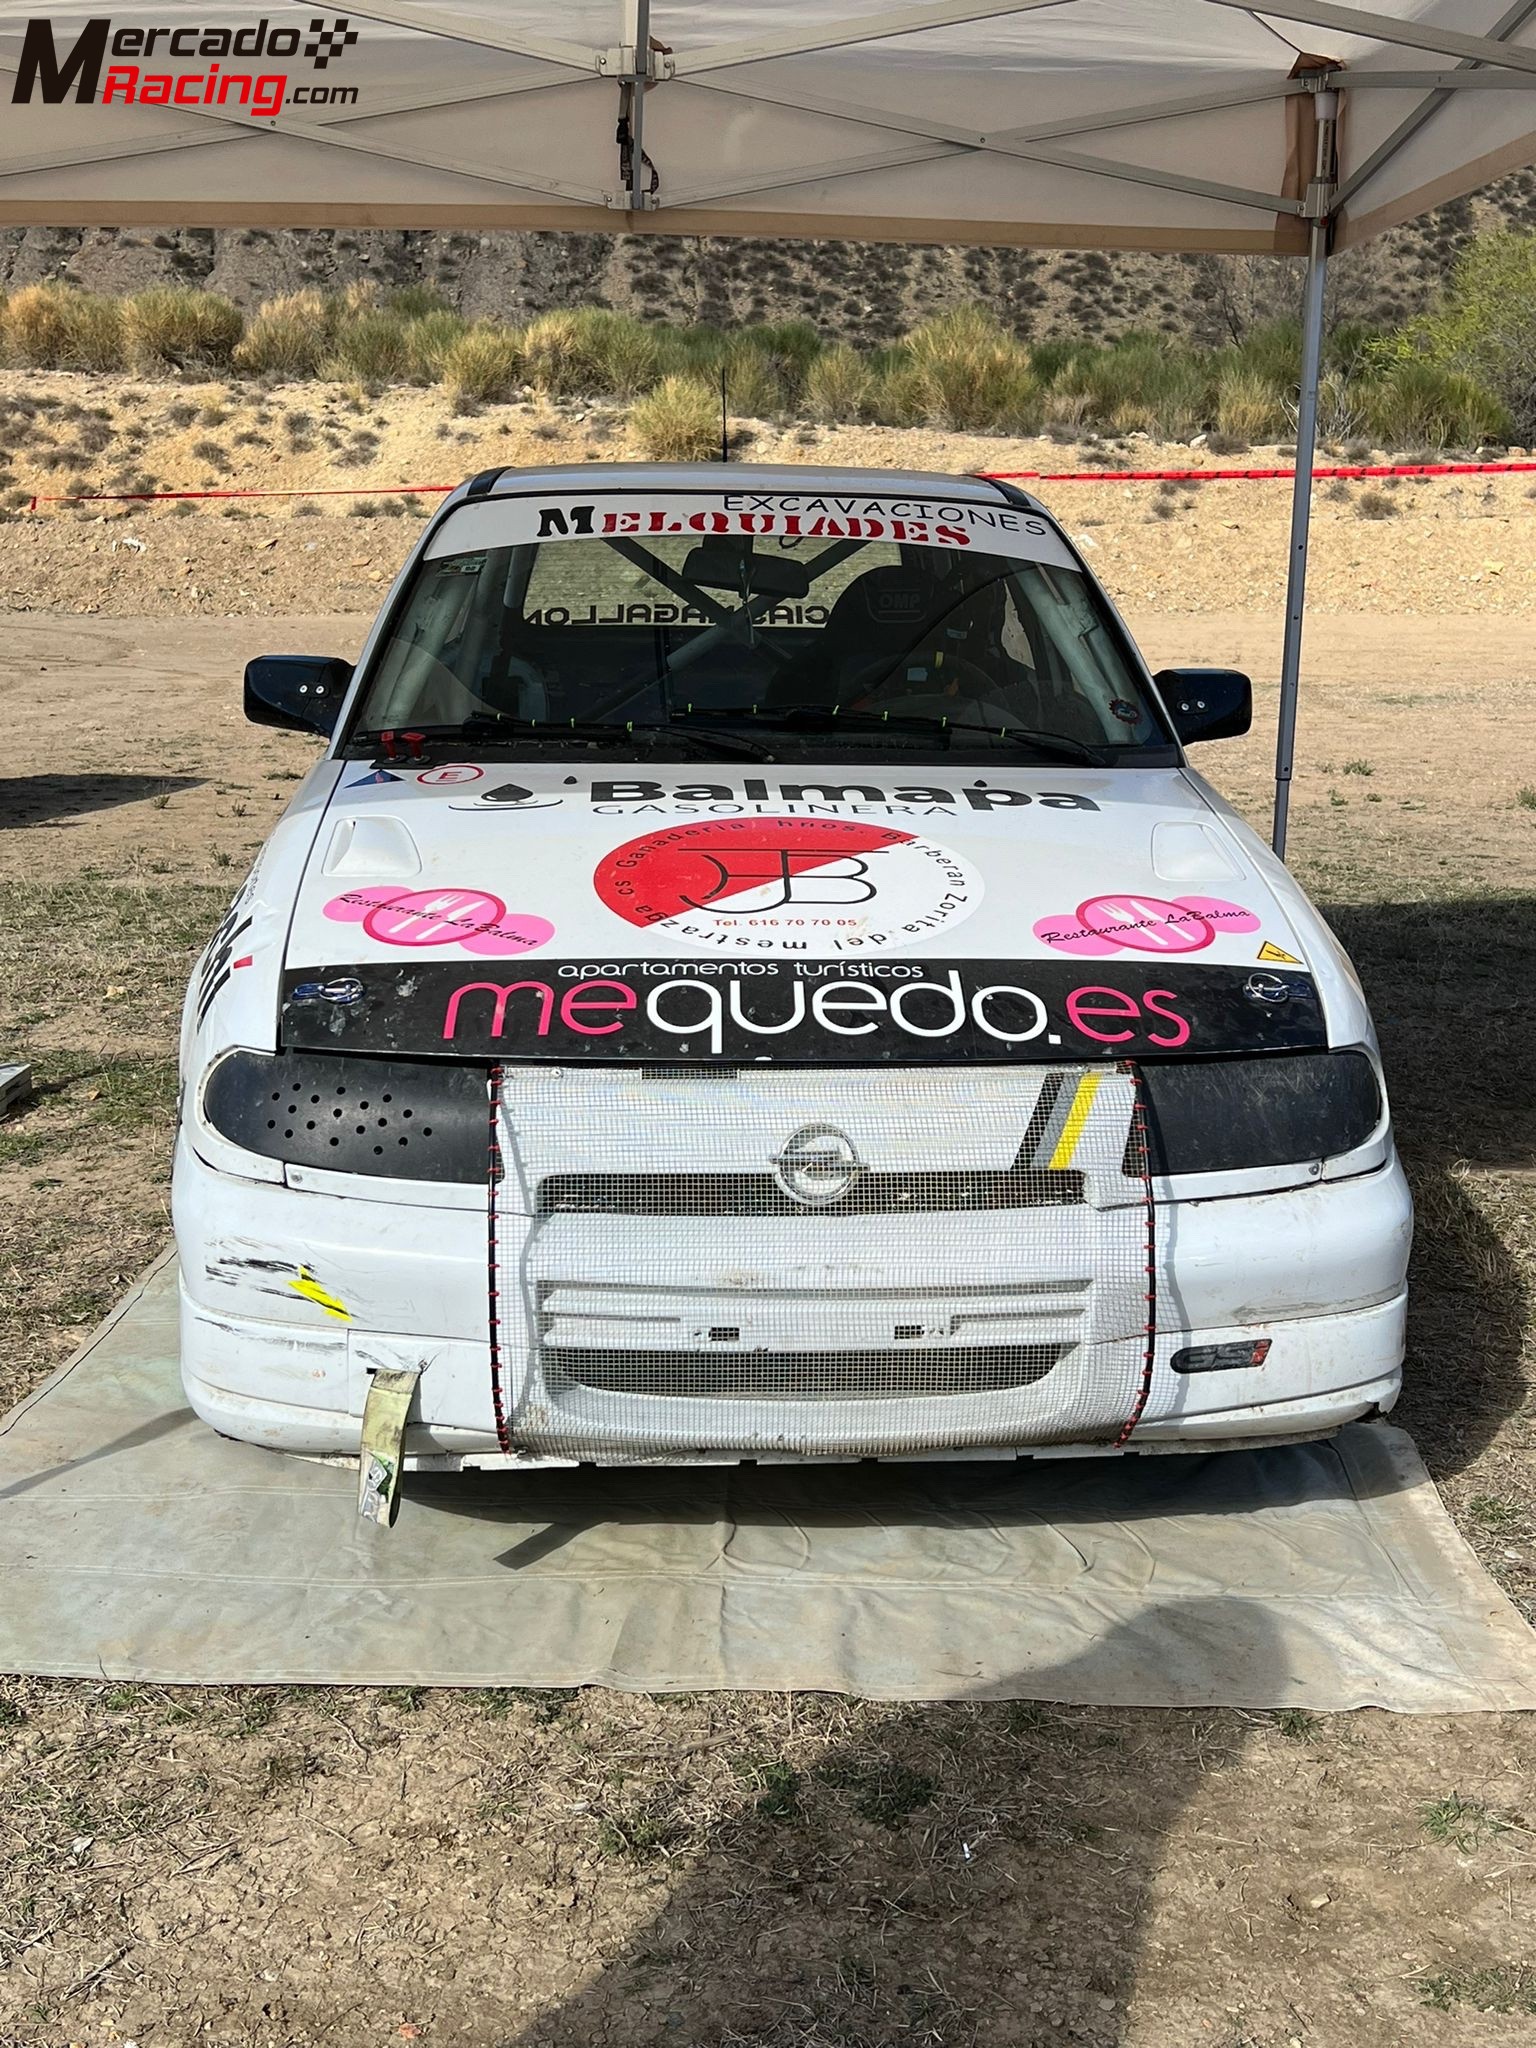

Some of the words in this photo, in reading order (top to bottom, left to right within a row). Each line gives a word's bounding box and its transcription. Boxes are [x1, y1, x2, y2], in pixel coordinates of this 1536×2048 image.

[536, 505, 971, 545] MELQUIADES
[723, 495, 1047, 536] EXCAVACIONES
[437, 771, 464, 781] E
[590, 779, 1101, 811] Balmapa
[592, 804, 957, 816] GASOLINERA
[616, 823, 745, 868] Ganaderia
[339, 893, 443, 921] Restaurante
[902, 893, 968, 933] Zorita
[748, 919, 780, 927] 616
[786, 919, 805, 927] 70
[811, 919, 831, 927] 70
[837, 919, 857, 927] 05
[1041, 919, 1158, 943] Restaurante
[834, 932, 887, 950] del
[557, 962, 779, 979] apartamentos
[793, 960, 924, 979] turísticos
[443, 970, 1190, 1054] mequedo.es
